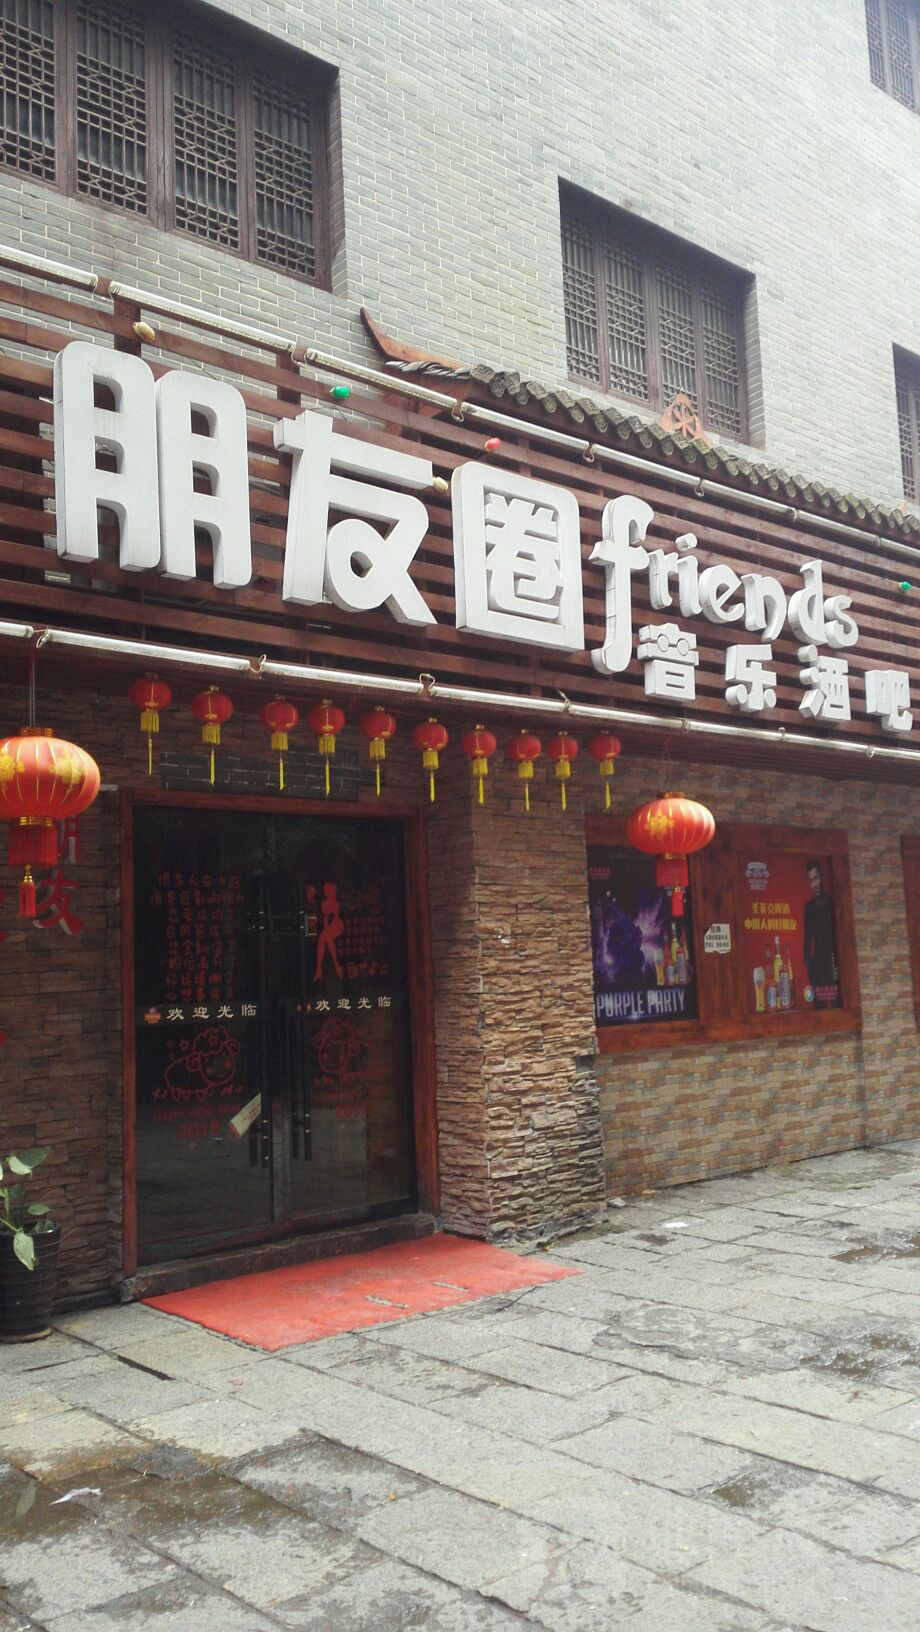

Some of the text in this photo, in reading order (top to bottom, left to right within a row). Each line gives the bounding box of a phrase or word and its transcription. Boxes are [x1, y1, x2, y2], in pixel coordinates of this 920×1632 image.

[53, 340, 585, 652] 朋友圈
[589, 495, 859, 674] friends
[637, 623, 913, 732] 音乐酒吧
[166, 1004, 258, 1021] 欢迎光临
[315, 996, 392, 1011] 欢迎光临
[596, 987, 685, 1018] PURPLE PARTY
